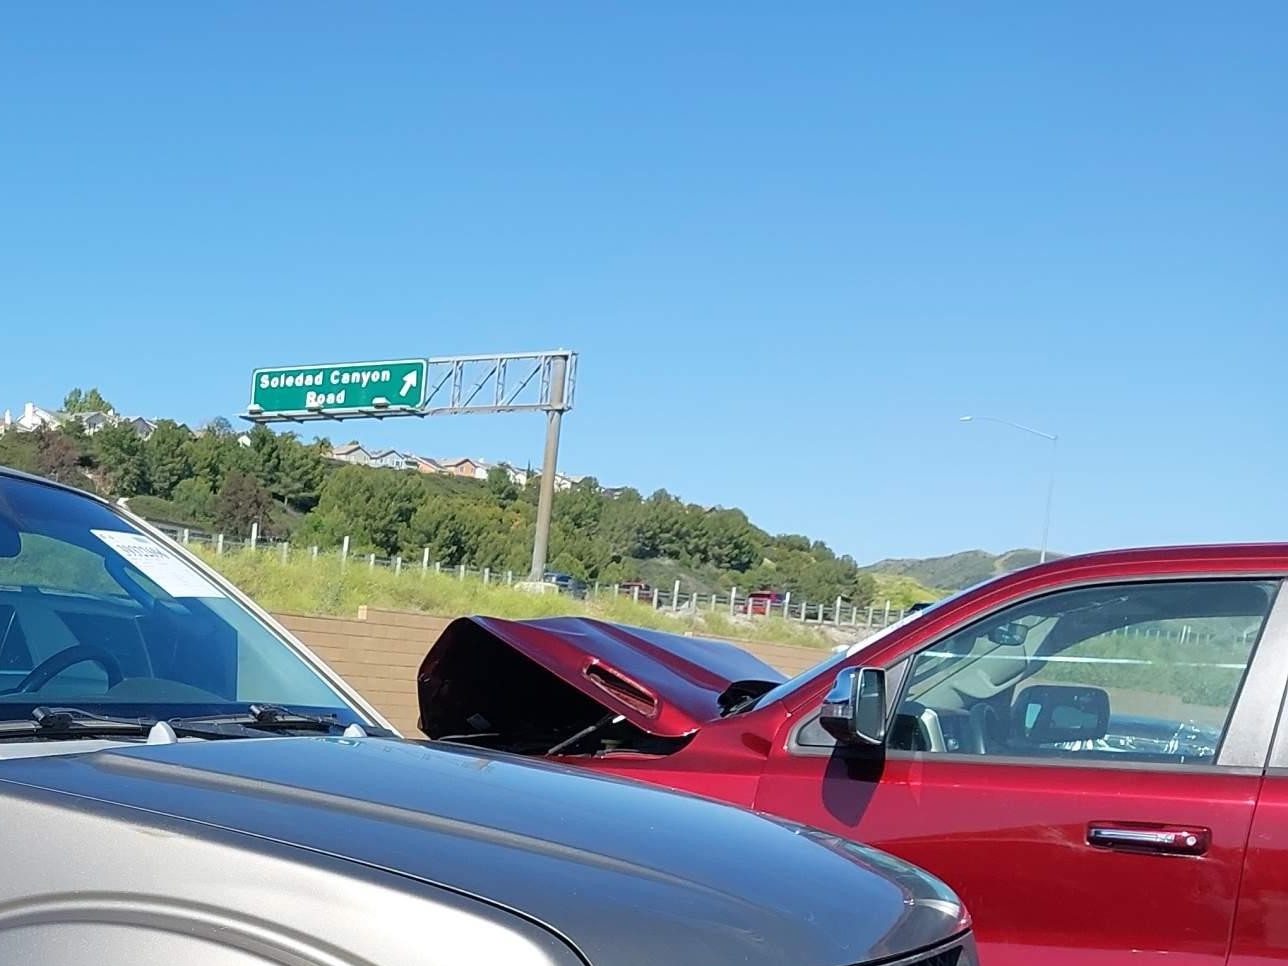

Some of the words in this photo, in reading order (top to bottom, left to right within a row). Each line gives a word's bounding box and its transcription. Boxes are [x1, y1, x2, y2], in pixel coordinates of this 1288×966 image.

[259, 371, 324, 389] Soledad
[329, 369, 391, 388] Canyon
[305, 390, 346, 407] Road
